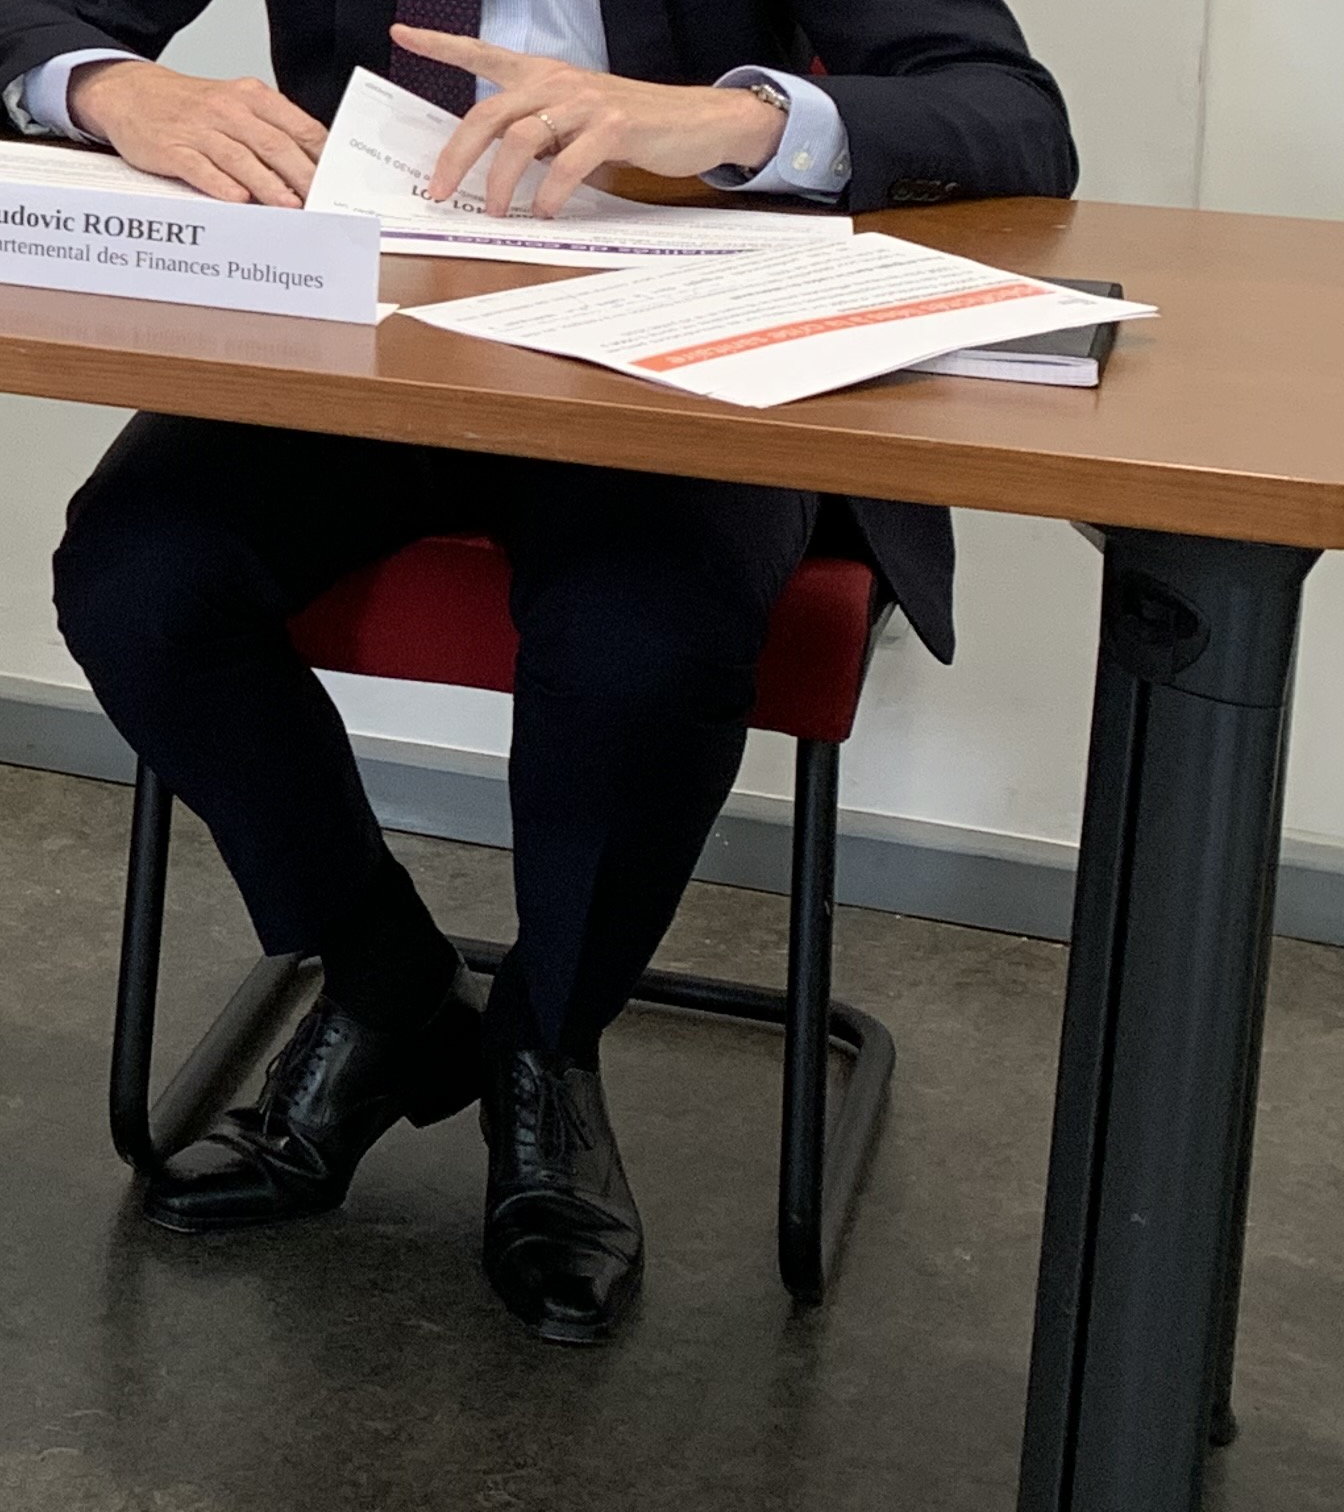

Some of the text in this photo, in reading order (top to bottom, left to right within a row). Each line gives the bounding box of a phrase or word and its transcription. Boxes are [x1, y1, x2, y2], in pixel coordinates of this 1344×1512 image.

[82, 211, 206, 247] ROBERT
[96, 244, 130, 267] des
[135, 250, 221, 279] Finances
[227, 260, 325, 291] Publiques
